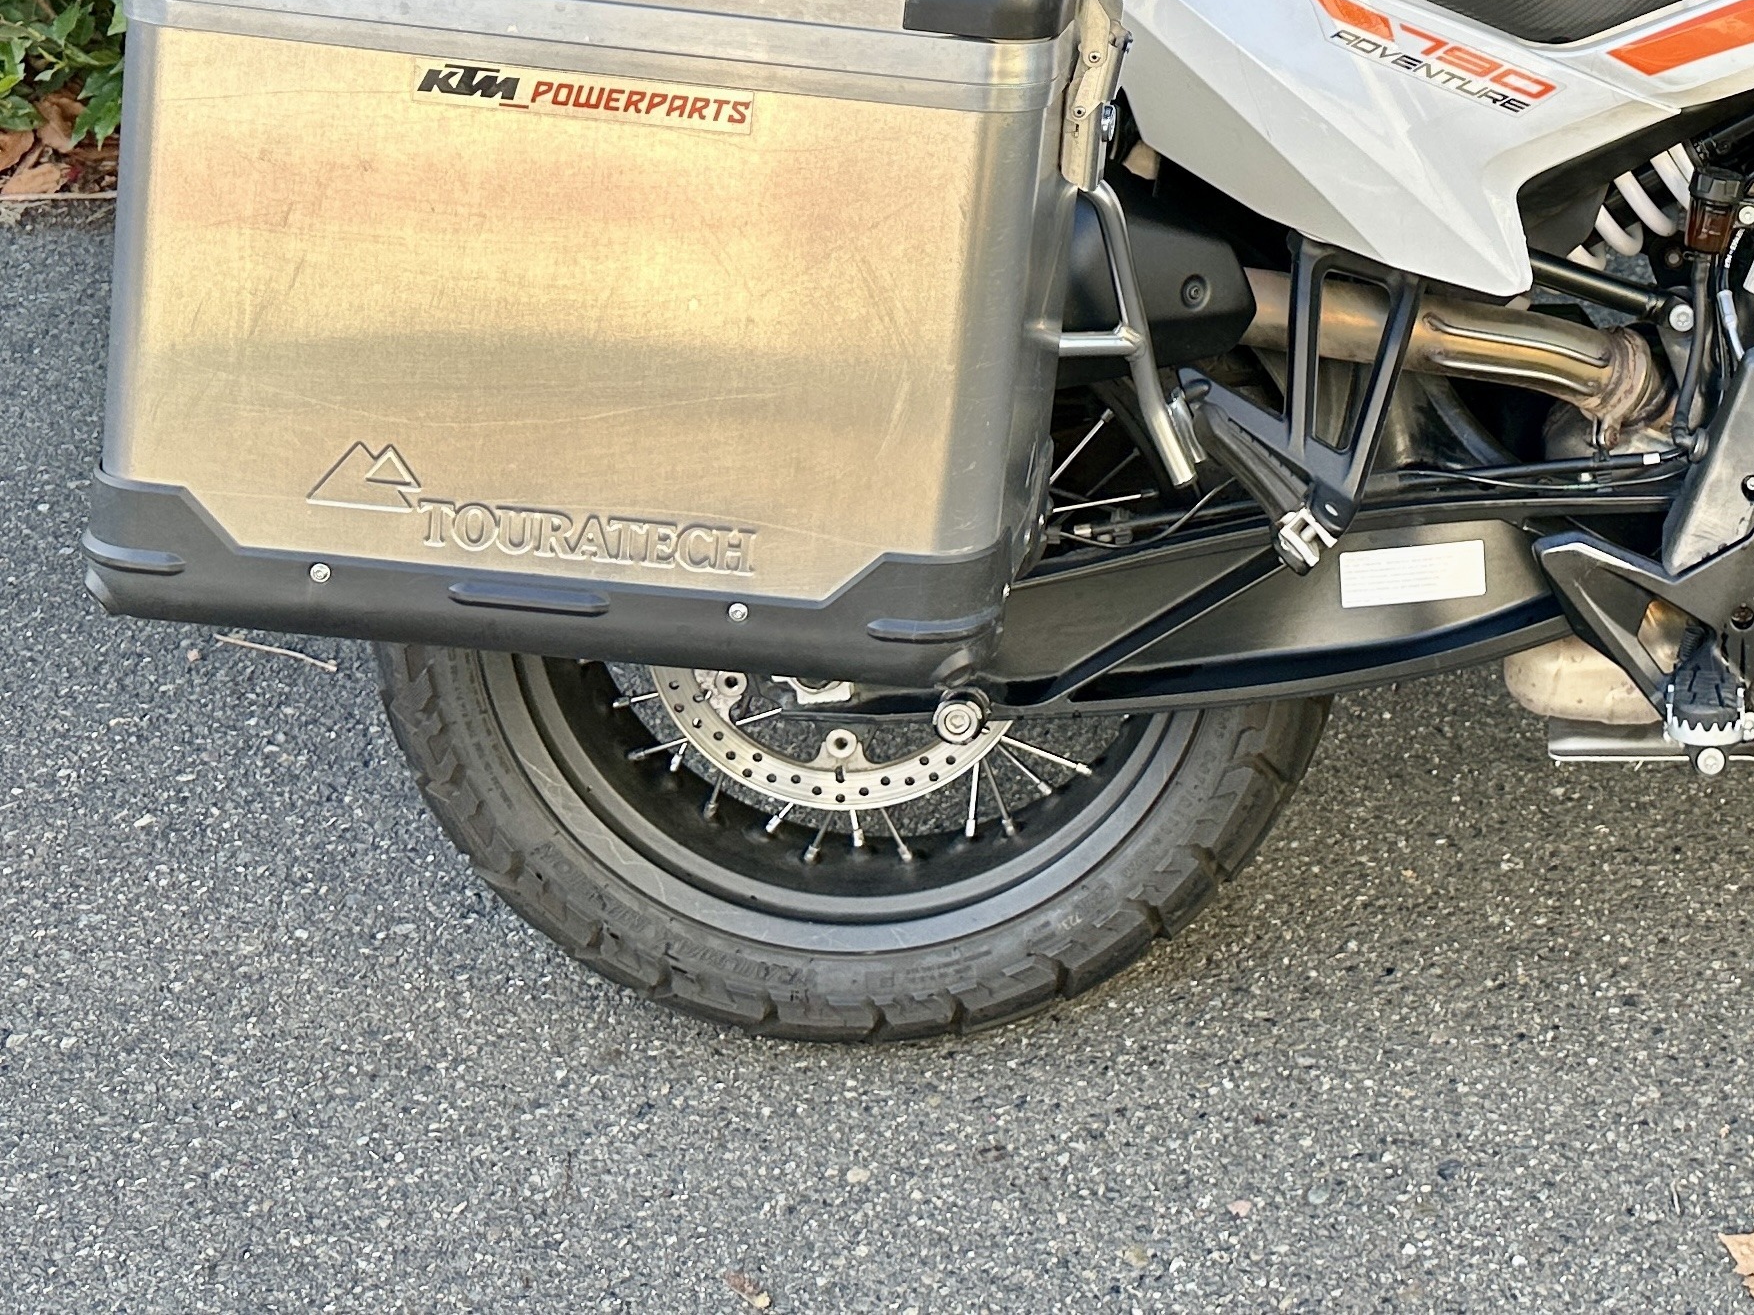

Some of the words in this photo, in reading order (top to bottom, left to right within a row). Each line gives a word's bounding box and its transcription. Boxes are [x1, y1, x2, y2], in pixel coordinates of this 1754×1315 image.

[417, 63, 520, 101] KTM
[530, 80, 752, 124] POWERPARTS
[1330, 29, 1530, 113] ADVENTURE
[1400, 23, 1557, 100] 790
[416, 497, 757, 577] TOURATECH
